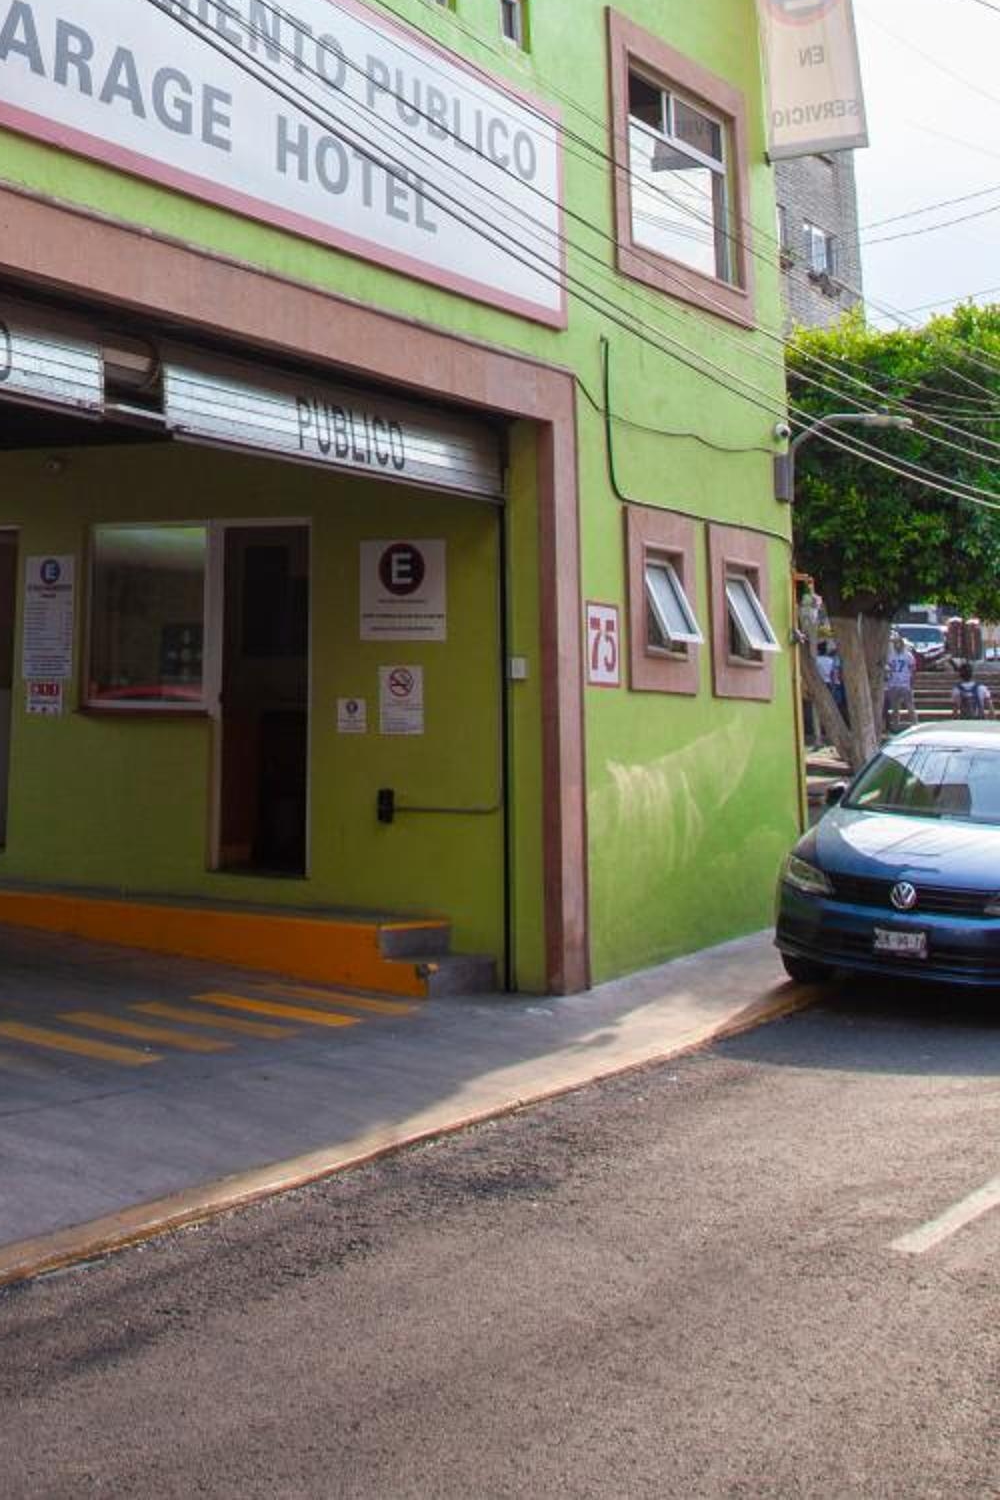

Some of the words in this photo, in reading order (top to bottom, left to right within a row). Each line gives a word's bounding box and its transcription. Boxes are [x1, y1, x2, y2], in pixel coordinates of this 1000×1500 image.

[365, 53, 538, 181] PUBLICO
[275, 113, 438, 234] HOTEL
[296, 393, 406, 471] PUBLICO
[390, 552, 413, 584] E
[589, 616, 617, 672] 75
